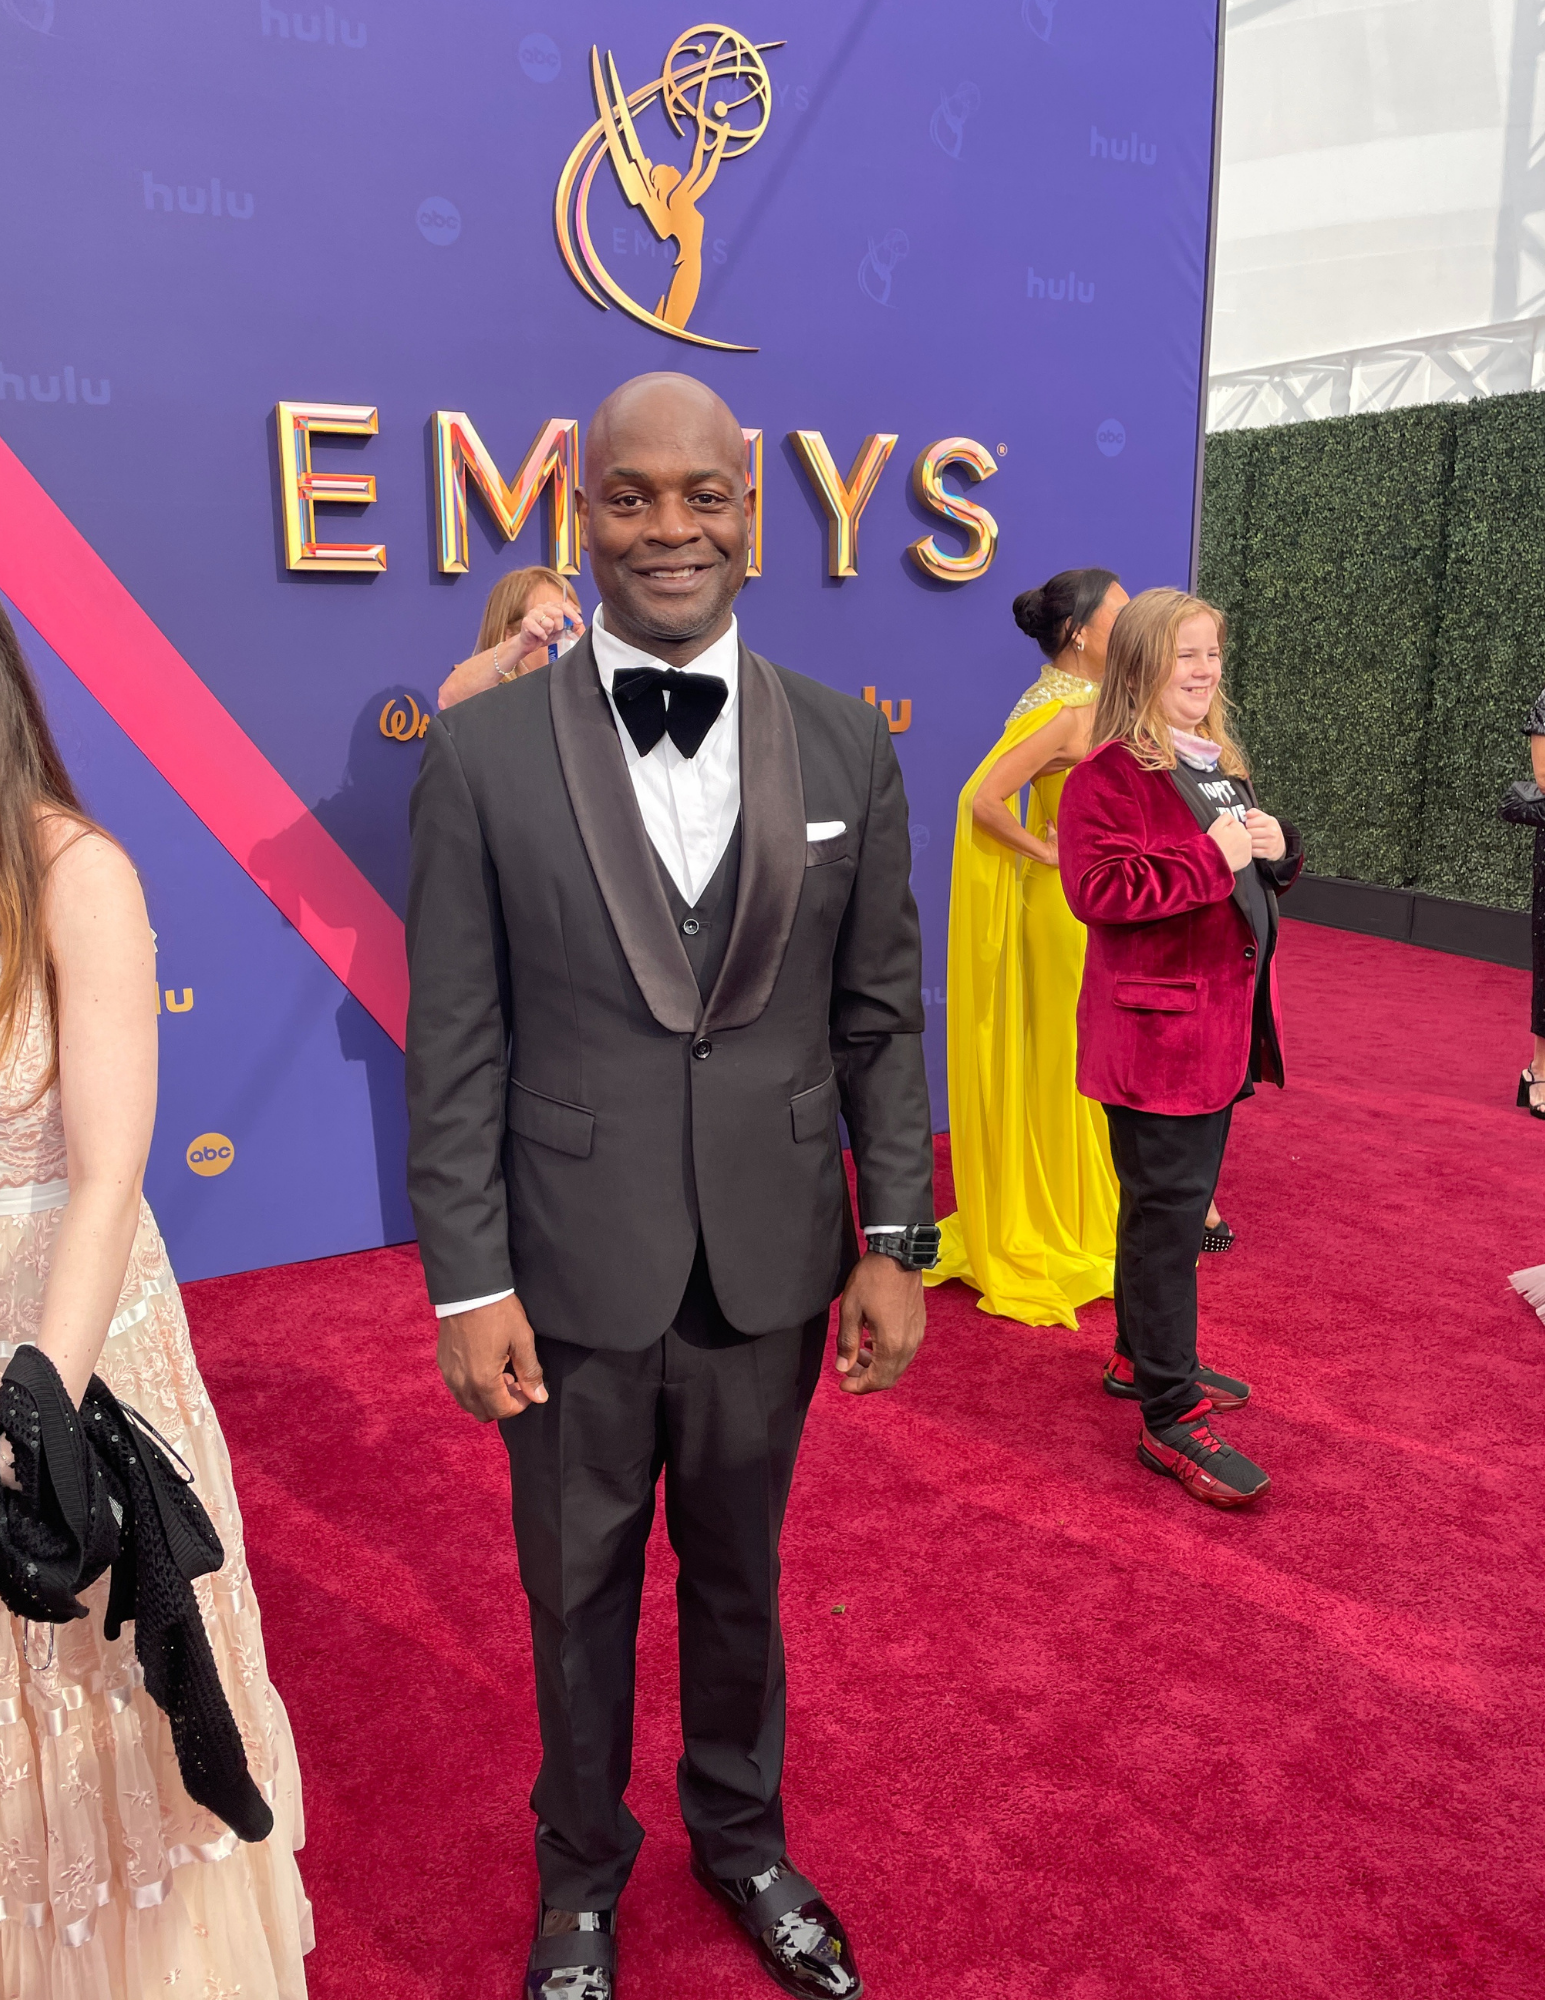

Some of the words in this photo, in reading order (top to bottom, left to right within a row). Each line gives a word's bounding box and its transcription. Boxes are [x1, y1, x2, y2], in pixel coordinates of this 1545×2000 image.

[260, 0, 367, 49] hulu
[521, 47, 559, 68] abc
[1090, 126, 1157, 165] hulu
[143, 171, 254, 218] hulu
[420, 209, 458, 230] abc
[1026, 267, 1095, 304] hulu
[0, 362, 111, 405] hulu
[1098, 430, 1124, 445] abc
[190, 1146, 231, 1163] abc
